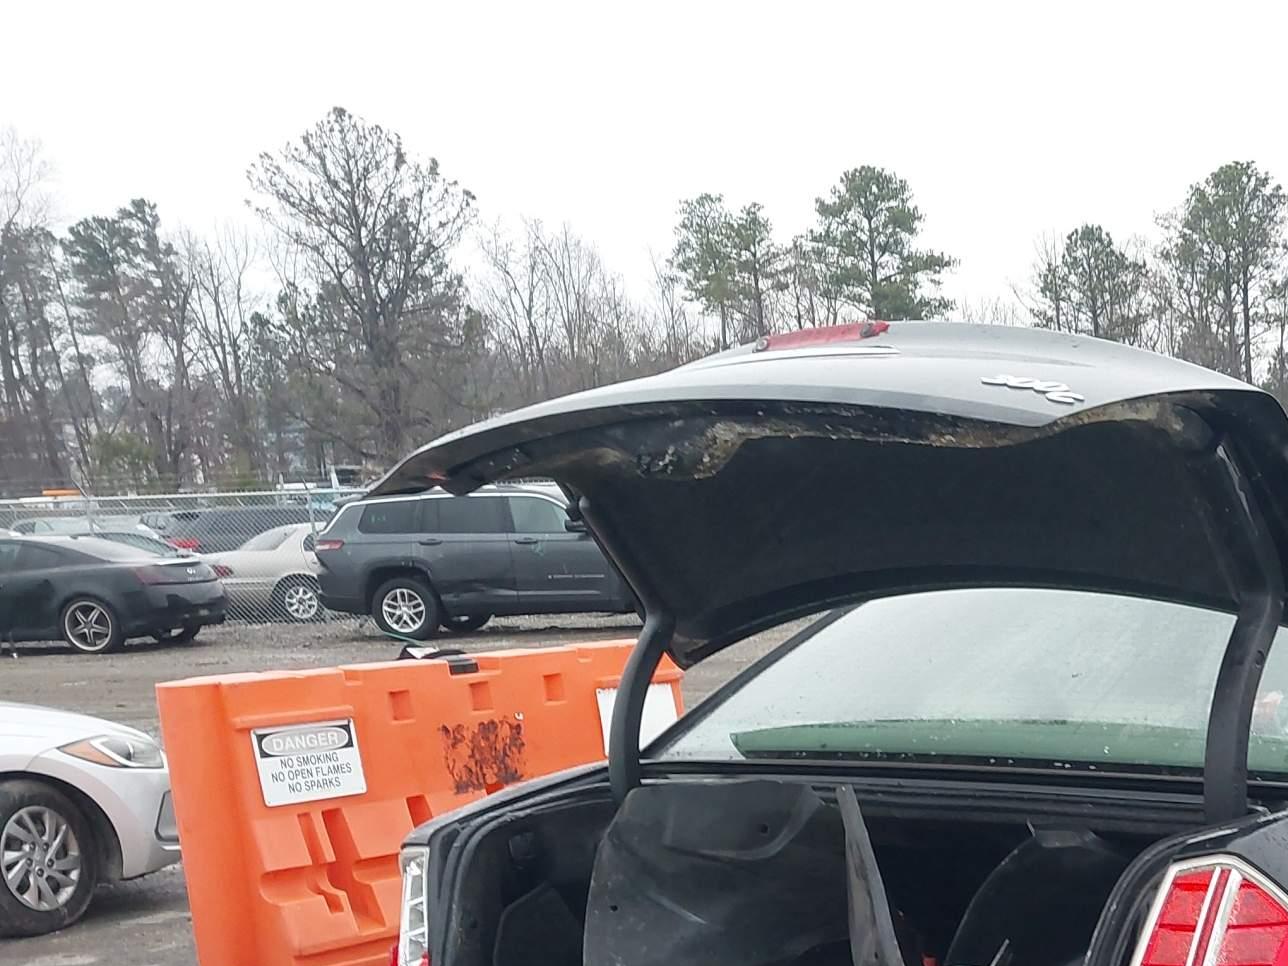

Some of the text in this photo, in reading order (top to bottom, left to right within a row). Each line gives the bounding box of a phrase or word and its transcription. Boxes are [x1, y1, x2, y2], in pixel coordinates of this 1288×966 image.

[272, 731, 338, 752] DANGER
[280, 752, 339, 769] NO SMOKING
[271, 762, 352, 783] NO OPEN FLAMES
[288, 776, 341, 794] NO SPARKS
